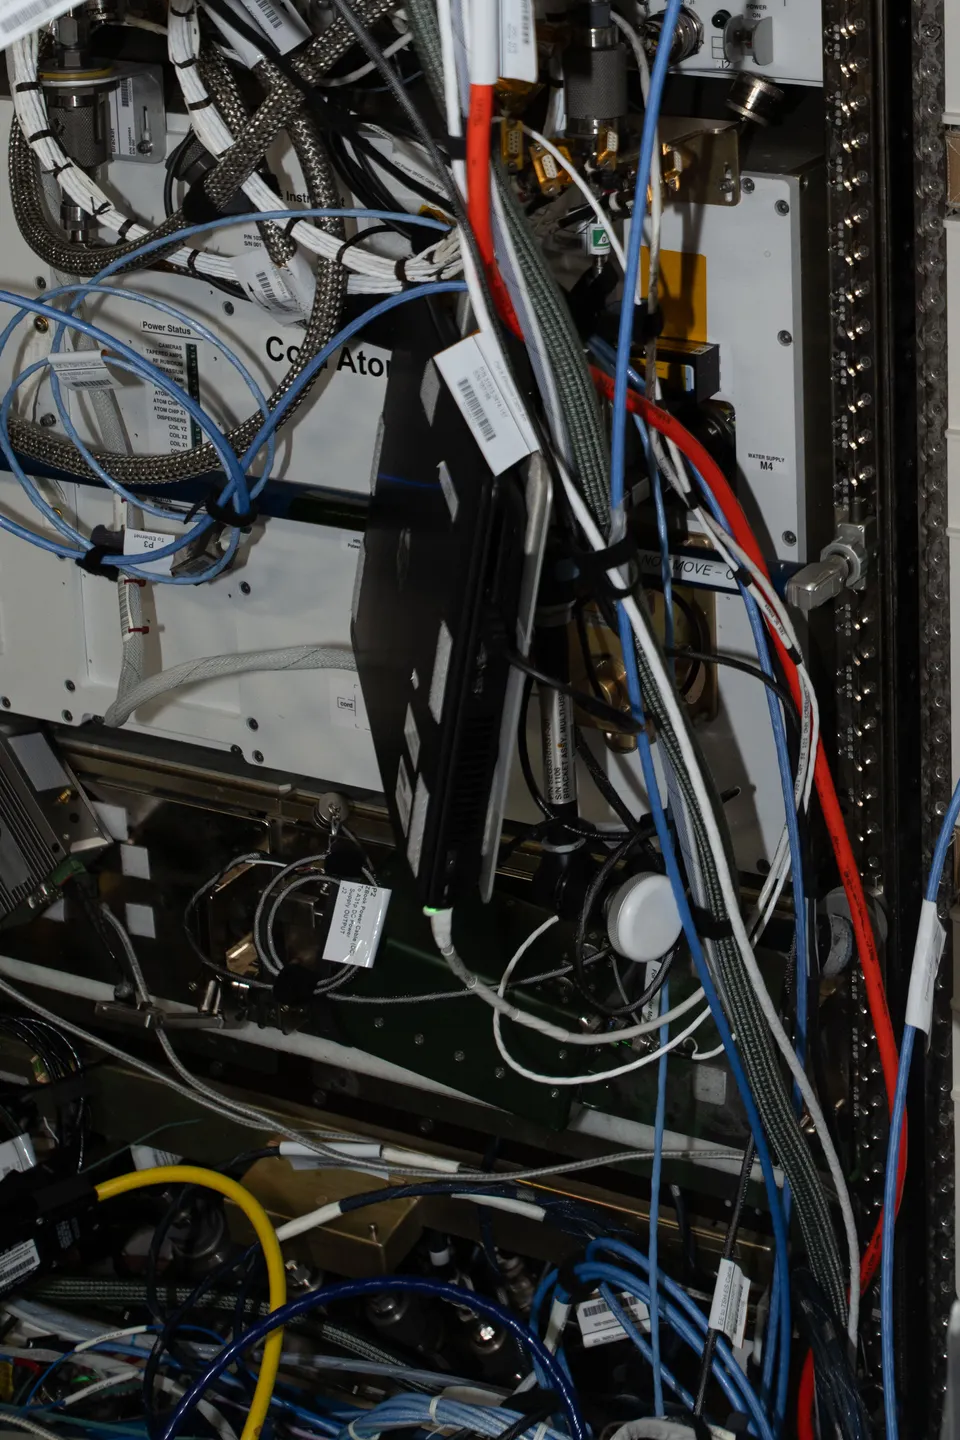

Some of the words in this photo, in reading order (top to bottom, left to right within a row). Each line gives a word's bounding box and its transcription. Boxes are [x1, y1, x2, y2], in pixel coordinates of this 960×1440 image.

[141, 320, 165, 331] Power
[167, 324, 191, 335] Status
[157, 342, 182, 351] CAMERAS
[145, 348, 169, 357] TAPERED
[169, 351, 183, 359] AMPS
[151, 356, 159, 364] RF
[159, 358, 183, 367] RUBIDIUM
[336, 345, 392, 378] Ato
[152, 397, 167, 405] ATOM
[156, 414, 187, 424] DISPENSERS
[747, 452, 765, 460] WATER
[765, 454, 785, 462] SUPPLY
[759, 460, 773, 471] M4
[133, 533, 156, 541] Ethernet
[143, 540, 154, 548] P3
[672, 559, 713, 577] MOVE
[339, 700, 353, 708] cord
[553, 766, 561, 784] 1106
[560, 760, 571, 799] BRACKET
[554, 786, 562, 800] S/N
[340, 886, 347, 894] J2
[356, 884, 363, 892] To
[369, 886, 377, 897] P2
[344, 887, 355, 908] Supply
[360, 884, 370, 904] ZBook
[349, 908, 356, 919] DC
[356, 904, 365, 924] Power
[338, 908, 350, 935] OUTPUT
[345, 918, 354, 938] Power
[351, 924, 361, 942] Cable
[717, 1316, 724, 1326] EE
